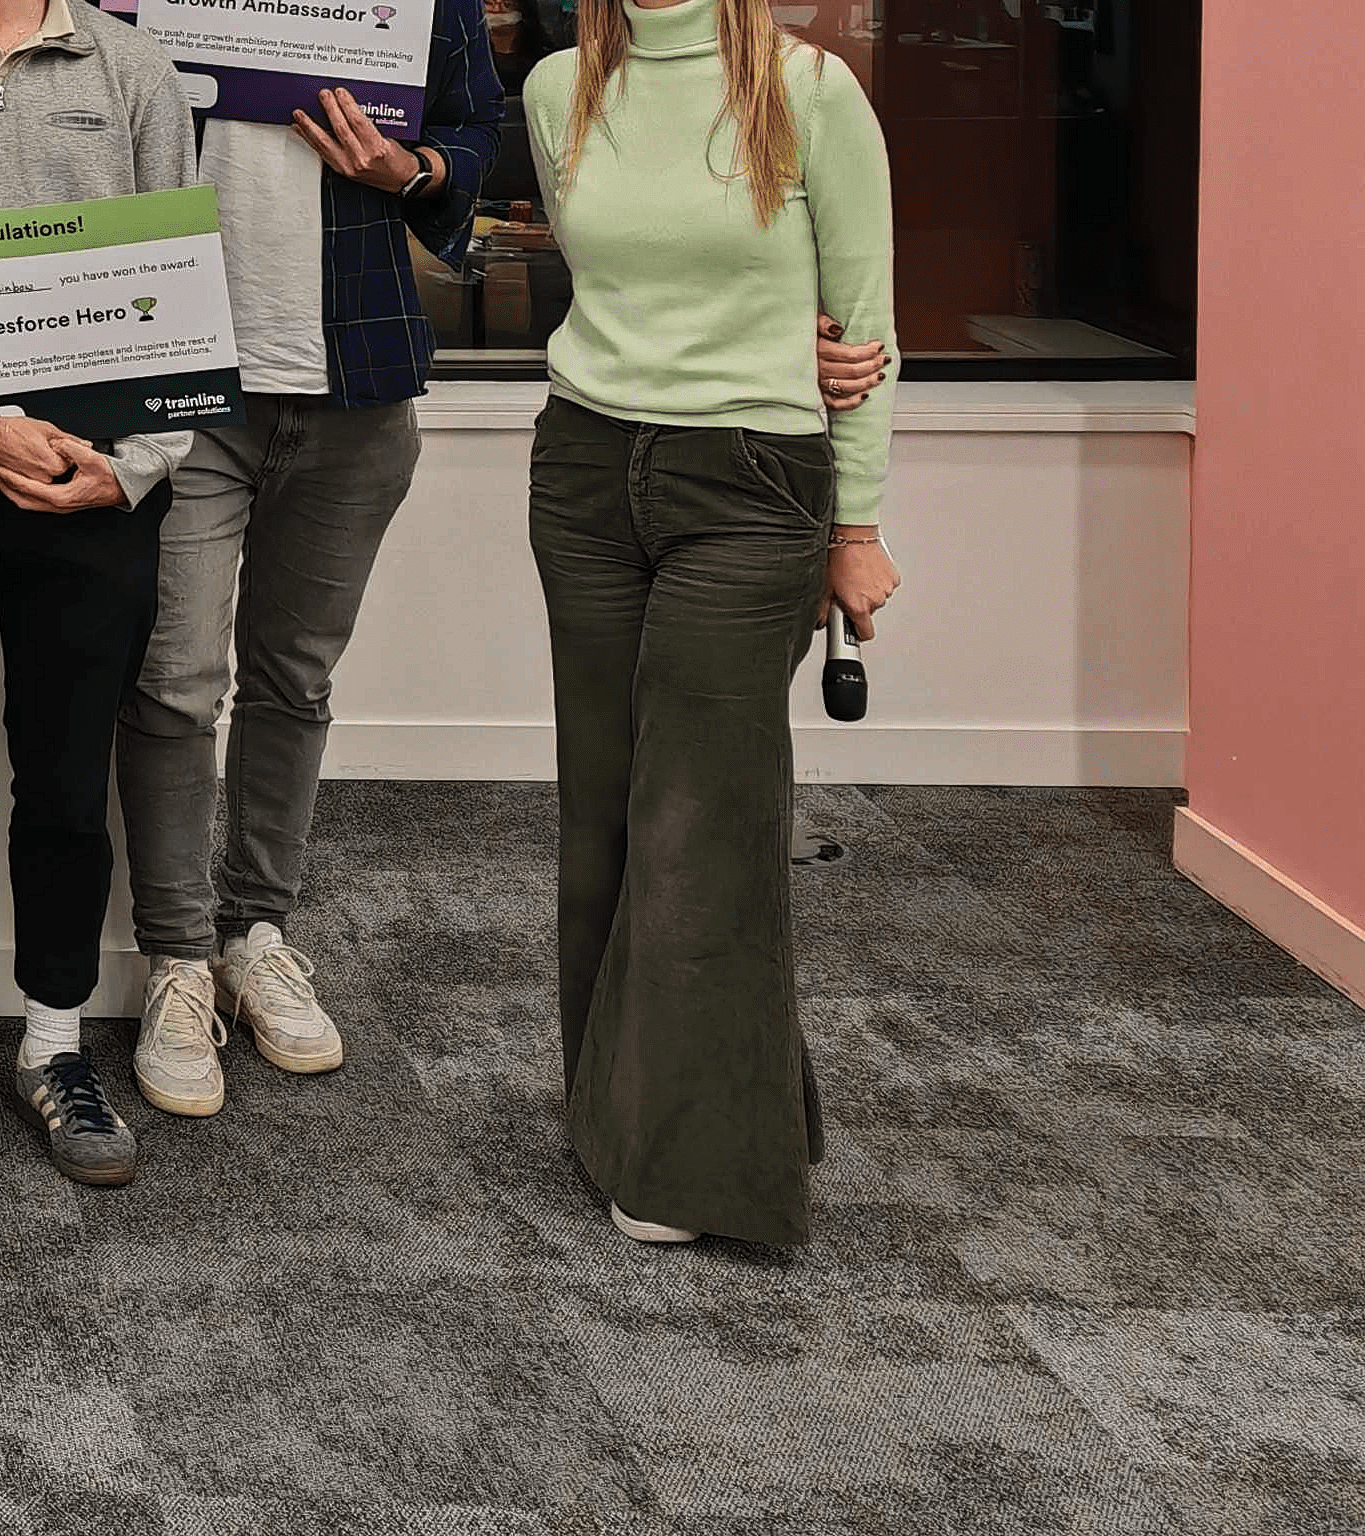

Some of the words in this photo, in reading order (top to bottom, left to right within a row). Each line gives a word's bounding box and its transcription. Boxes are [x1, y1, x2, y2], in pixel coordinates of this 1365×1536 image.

[59, 274, 81, 287] you
[82, 271, 110, 281] have
[111, 267, 137, 278] won
[138, 263, 158, 274] the
[160, 256, 199, 272] award:
[76, 307, 127, 326] Hero
[164, 392, 225, 410] trainline
